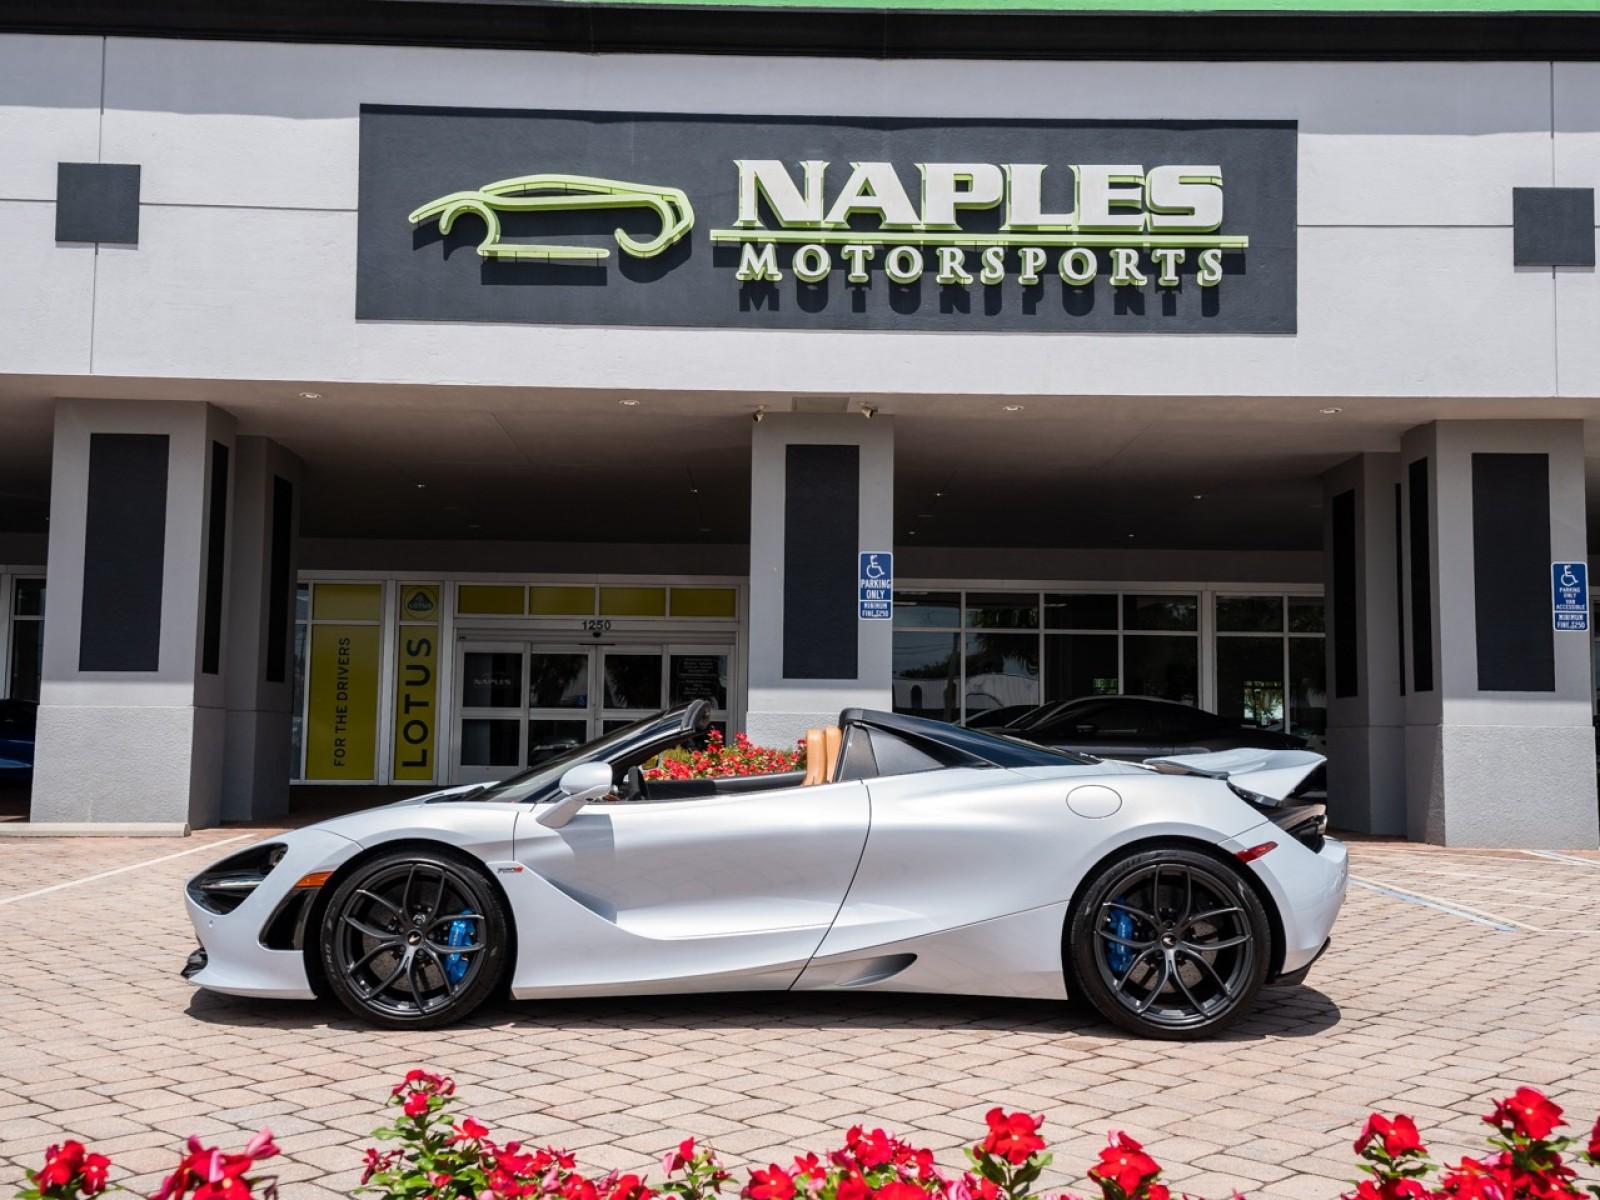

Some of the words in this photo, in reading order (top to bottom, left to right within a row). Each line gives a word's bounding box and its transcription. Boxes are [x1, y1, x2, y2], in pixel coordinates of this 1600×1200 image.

[732, 159, 1224, 232] NAPLES
[735, 243, 1223, 287] MOTORSPORTS
[861, 579, 891, 589] PARKING
[866, 590, 885, 599] ONLY
[582, 620, 611, 631] 1250
[336, 637, 351, 701] DRIVERS
[402, 638, 432, 768] LOTUS
[335, 704, 348, 733] THE
[333, 738, 347, 767] FOR
